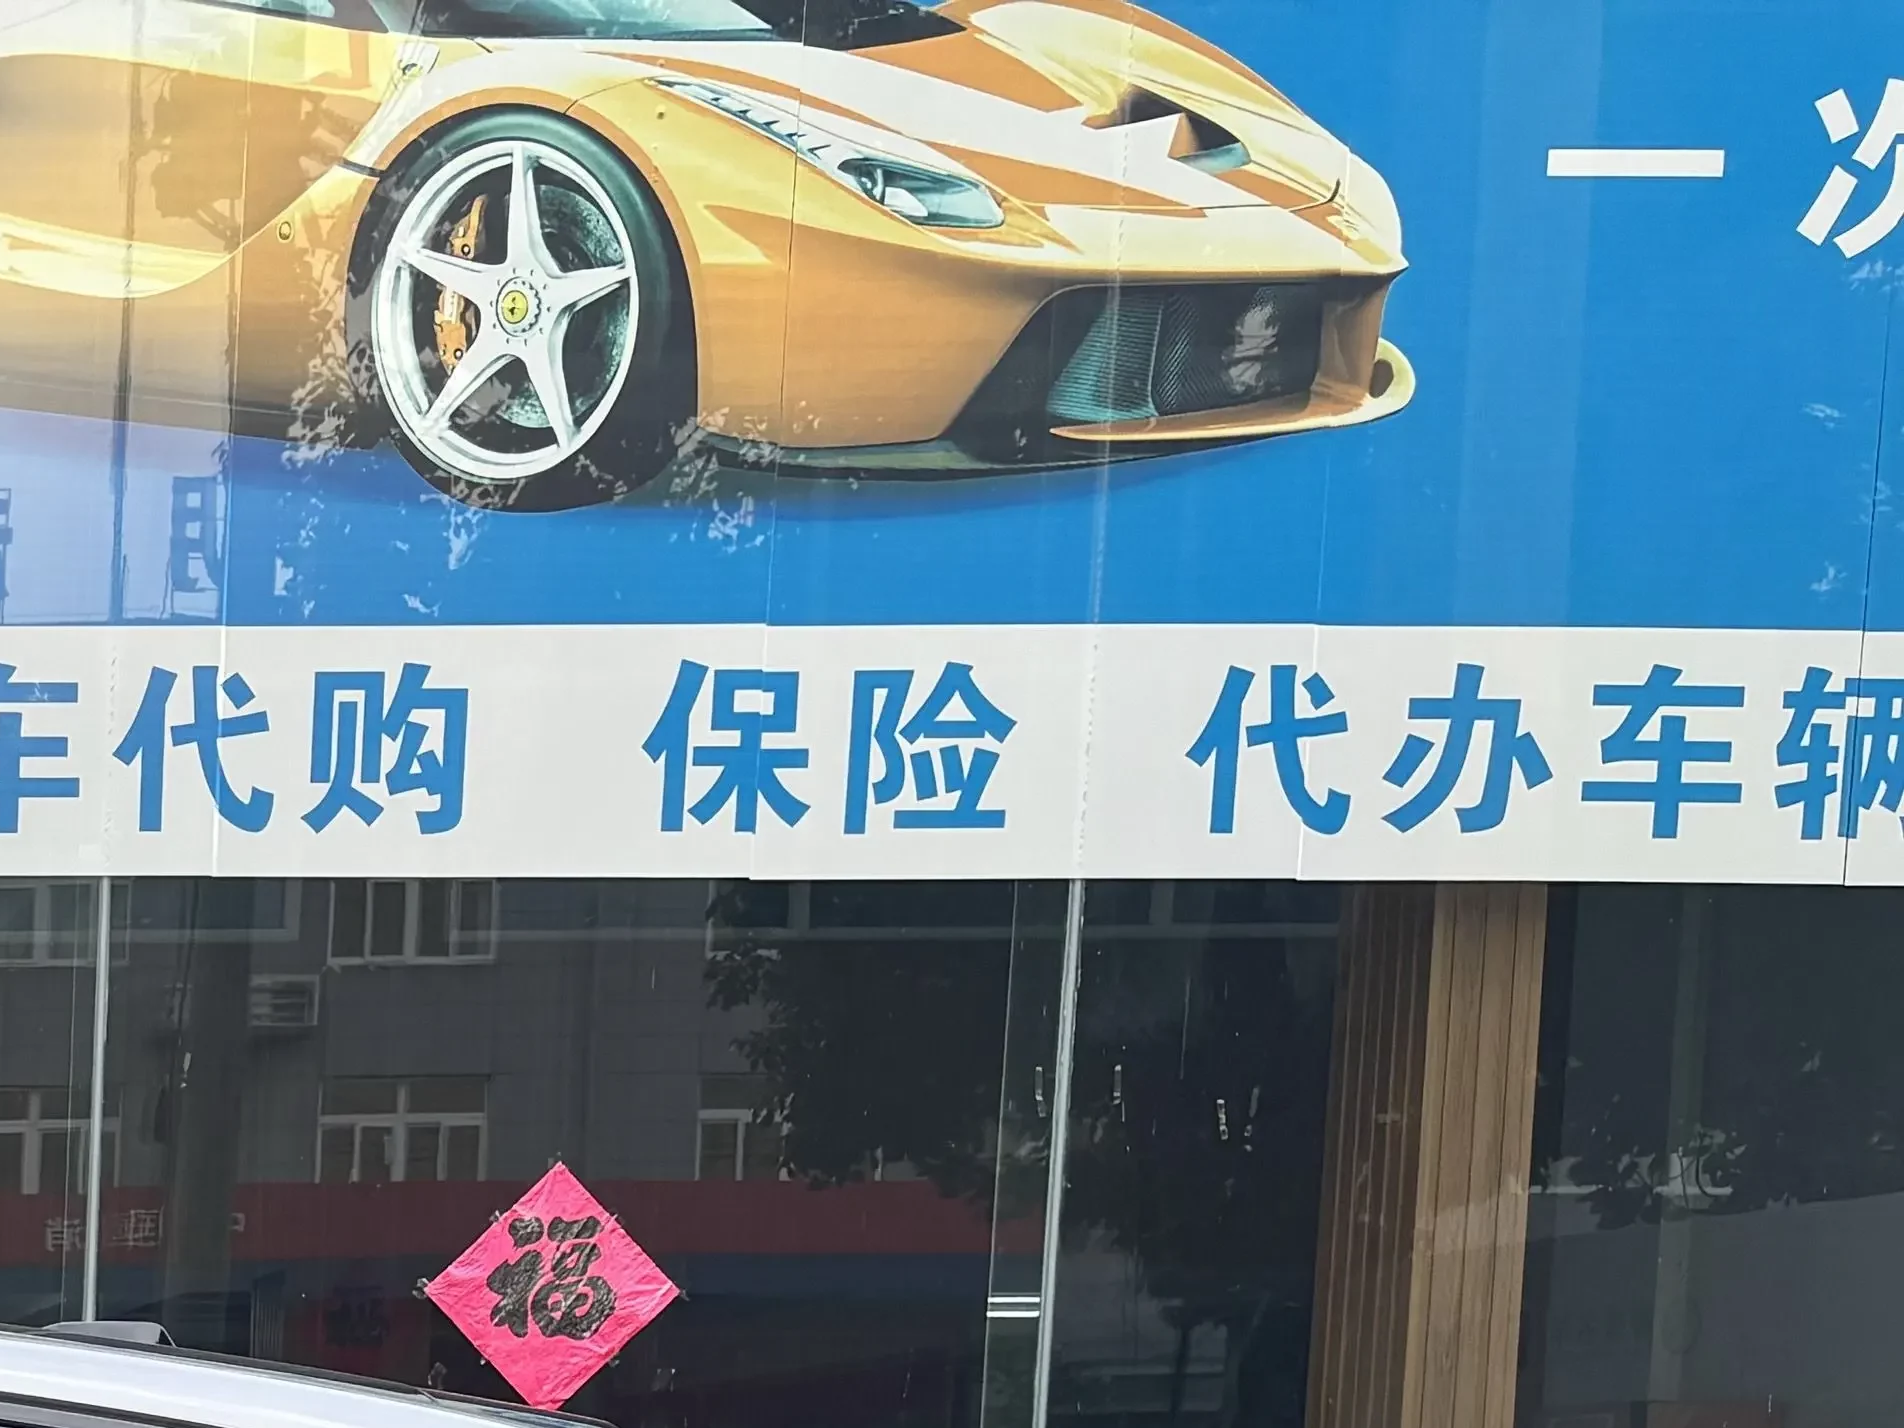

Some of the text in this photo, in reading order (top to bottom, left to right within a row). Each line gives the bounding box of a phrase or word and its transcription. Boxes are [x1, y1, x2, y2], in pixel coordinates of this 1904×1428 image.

[642, 659, 1019, 837] 保险
[1186, 660, 1904, 842] 代办车辆
[484, 1215, 617, 1341] 福
